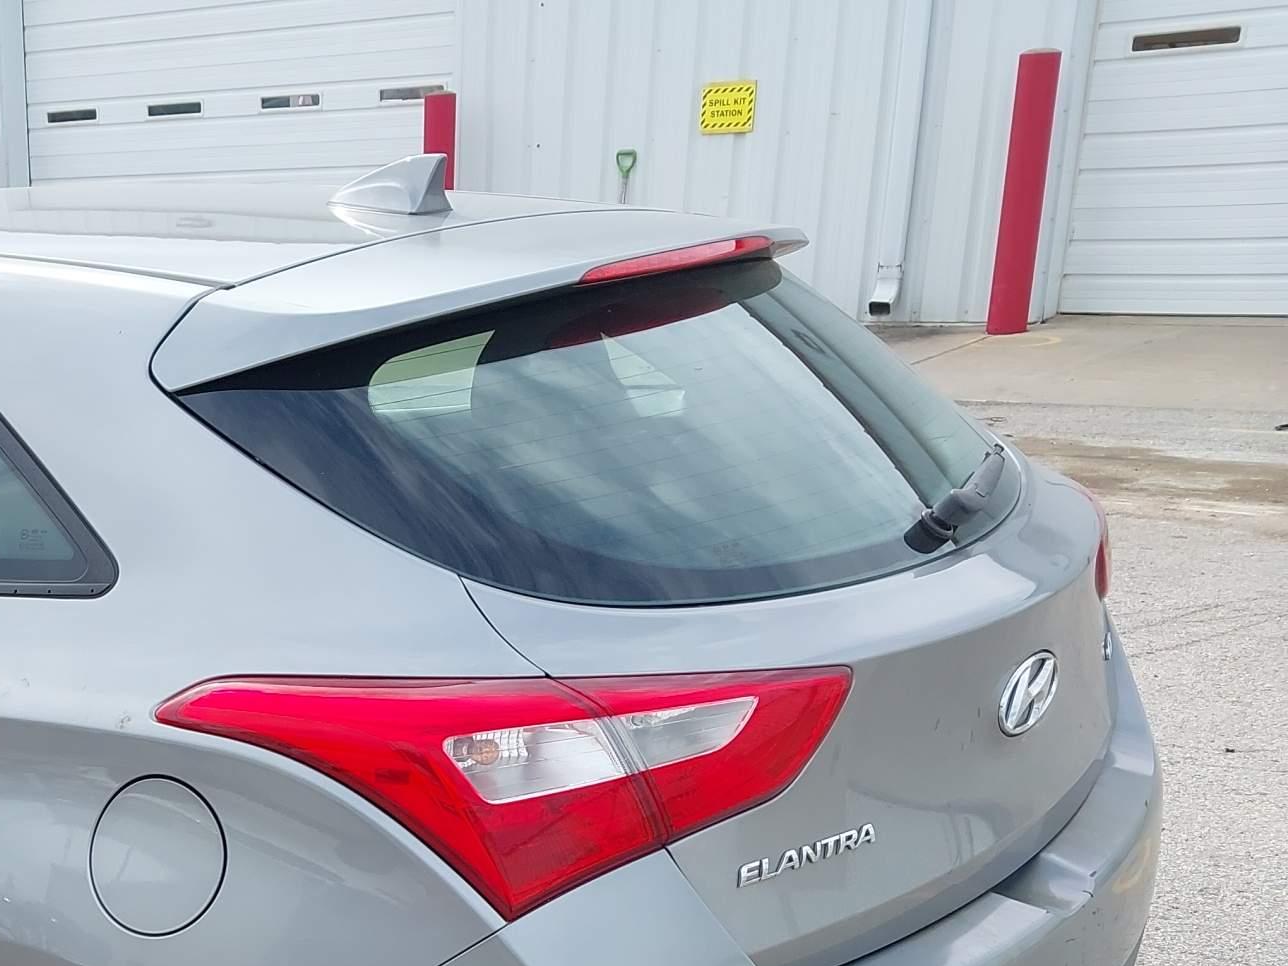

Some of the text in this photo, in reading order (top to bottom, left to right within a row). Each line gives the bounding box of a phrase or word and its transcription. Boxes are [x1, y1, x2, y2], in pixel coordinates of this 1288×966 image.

[708, 97, 747, 107] SPILL KIT
[710, 109, 743, 118] STATION
[736, 822, 876, 888] ELANTRA
